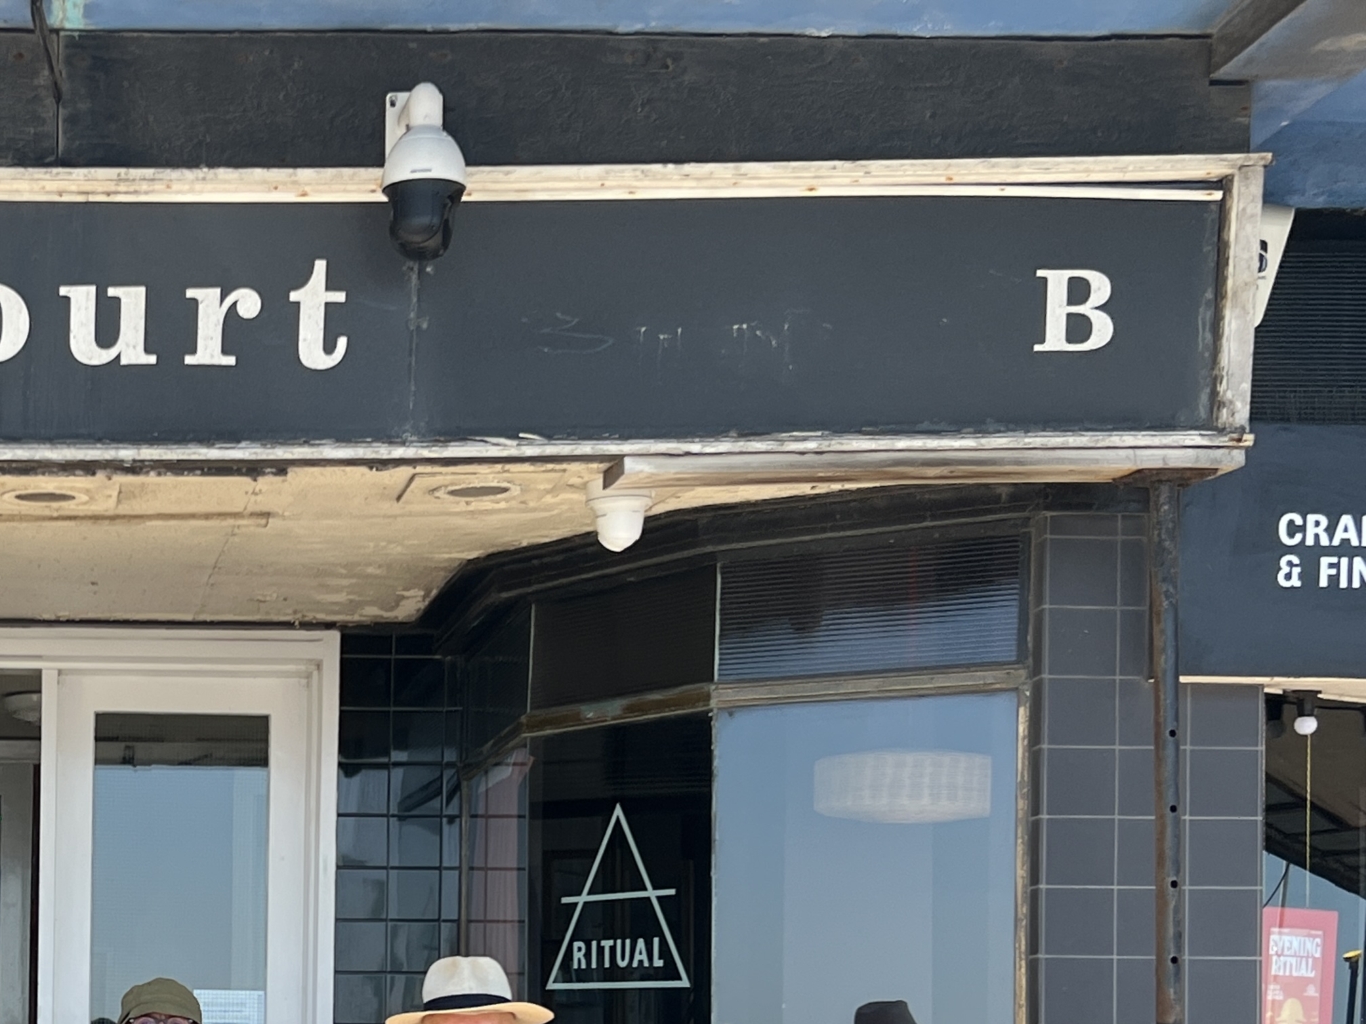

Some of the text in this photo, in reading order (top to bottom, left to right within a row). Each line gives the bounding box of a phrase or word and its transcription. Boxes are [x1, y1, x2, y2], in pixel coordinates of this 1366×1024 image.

[1033, 269, 1115, 353] B
[1277, 512, 1366, 547] CRA
[1276, 554, 1302, 588] &
[572, 937, 664, 970] RITUAL
[1269, 934, 1321, 957] EVENING
[1271, 956, 1315, 977] RITUAL
